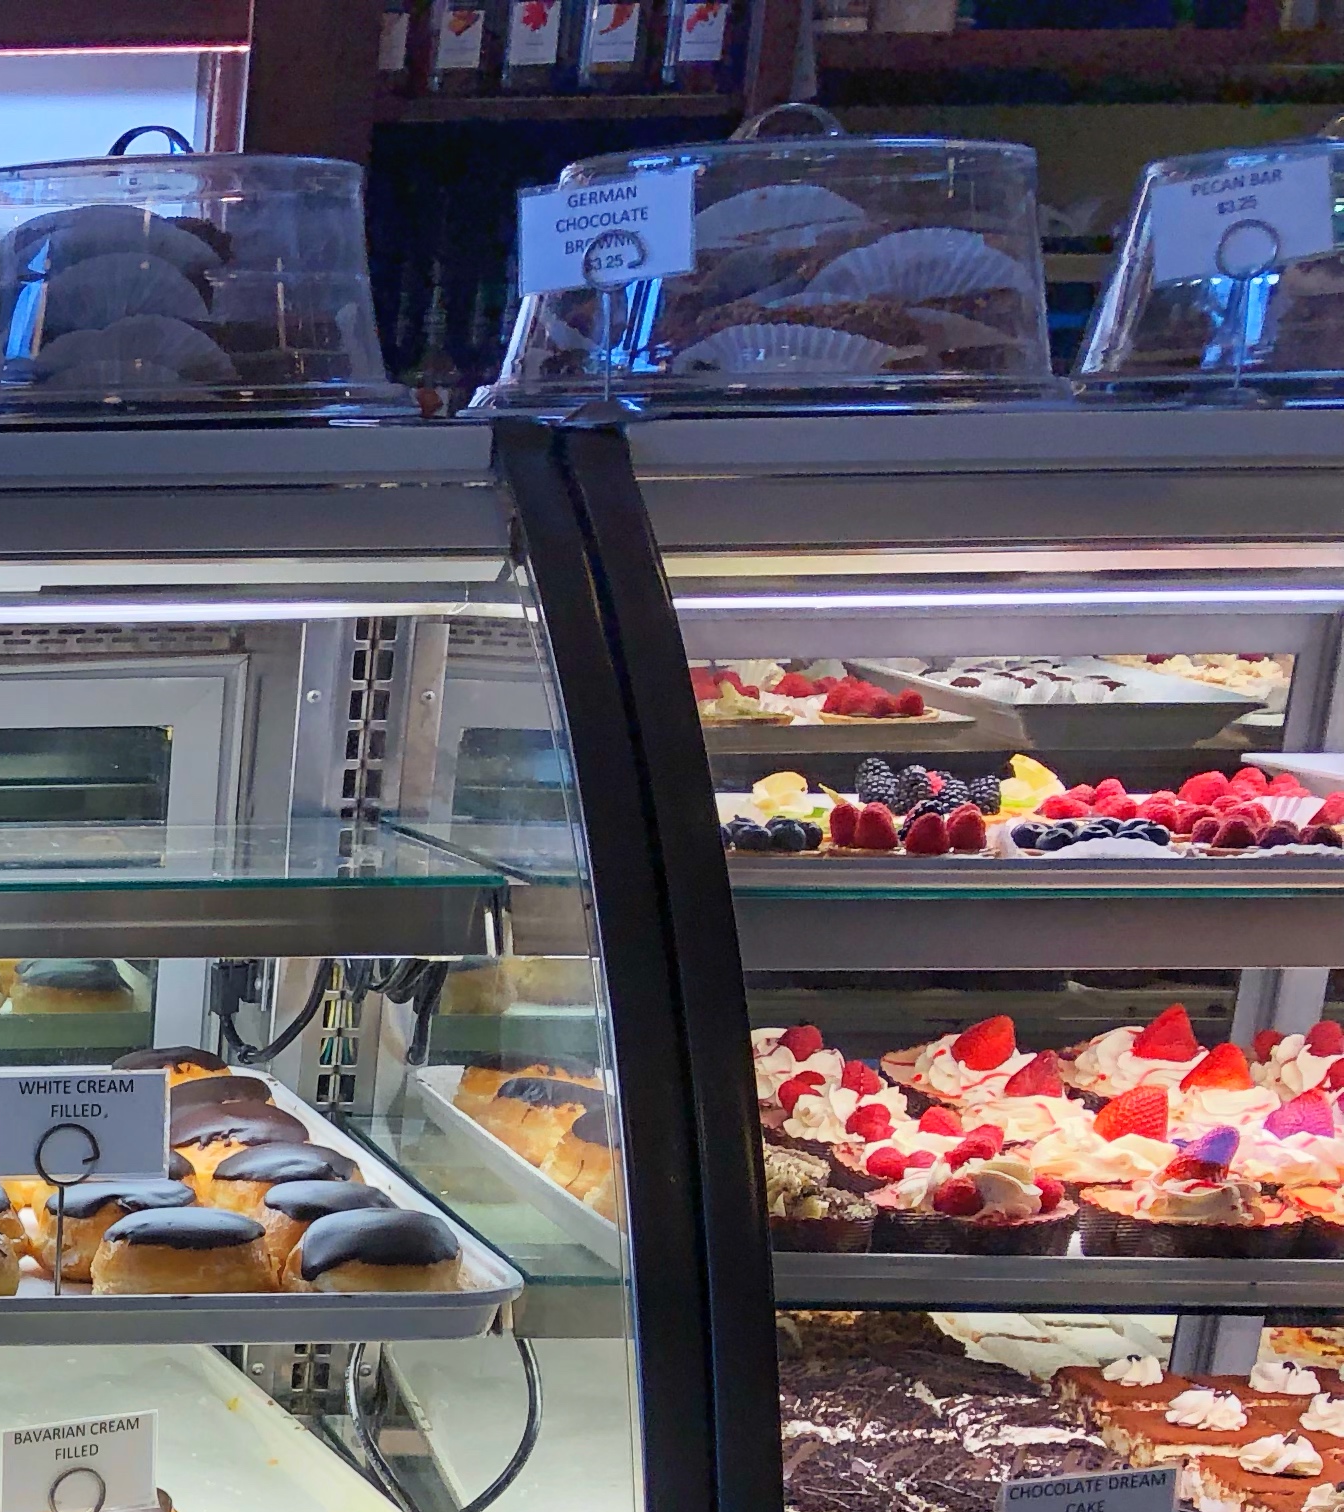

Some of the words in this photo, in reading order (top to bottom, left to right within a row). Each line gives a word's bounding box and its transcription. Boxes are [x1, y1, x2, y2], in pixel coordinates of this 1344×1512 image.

[1190, 175, 1245, 197] PECAN
[1250, 169, 1283, 187] BAR
[567, 185, 638, 208] GERMAN
[555, 206, 650, 233] CHOCOLATE
[565, 230, 641, 255] BRWNI
[18, 1080, 72, 1095] WHITE
[76, 1078, 135, 1094] CREAM
[13, 1424, 86, 1445] BAVARIAN
[90, 1417, 140, 1436] CREAM
[55, 1443, 100, 1460] FILLED
[1009, 1478, 1103, 1500] CHOCOLATE
[1108, 1473, 1167, 1491] DREAM
